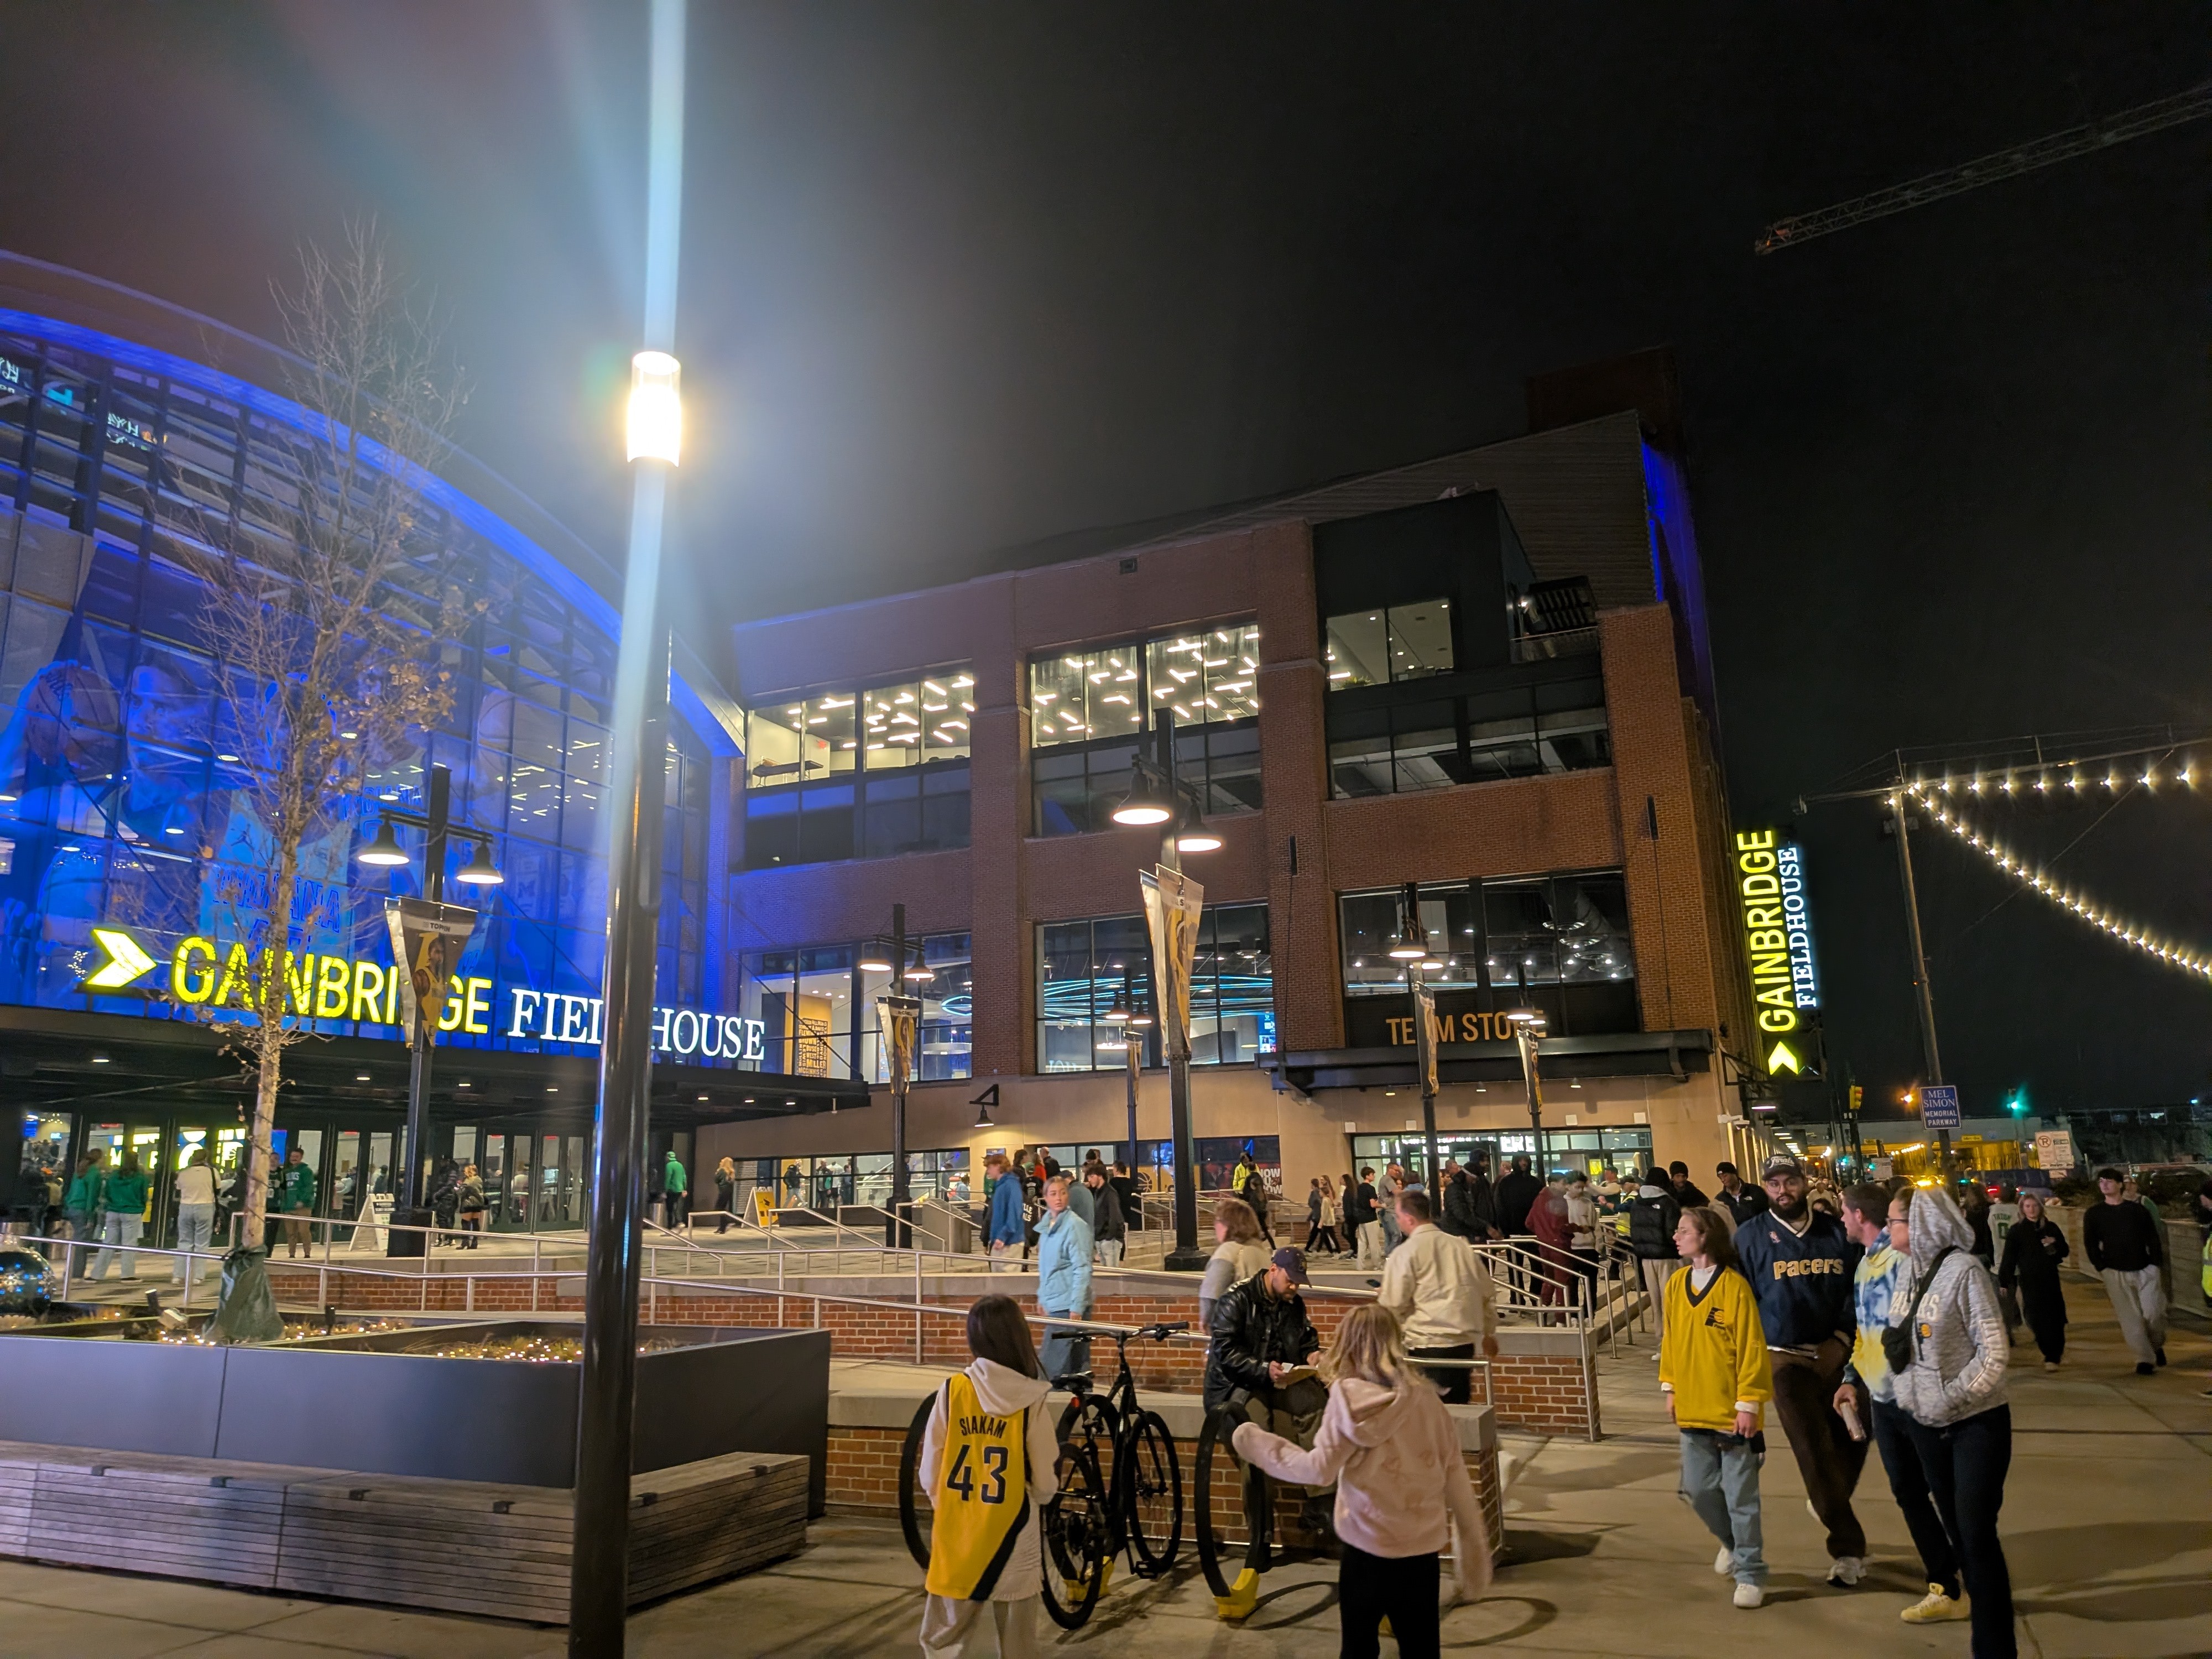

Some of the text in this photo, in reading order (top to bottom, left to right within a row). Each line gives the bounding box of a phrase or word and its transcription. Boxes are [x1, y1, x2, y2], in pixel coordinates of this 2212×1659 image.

[1737, 830, 1796, 1032] GAINBRIDGE
[1777, 847, 1817, 1008] FIELDHOUSE
[173, 935, 492, 1034] GAINBRIGE
[508, 989, 765, 1060] FIELHOUSE
[1386, 1014, 1455, 1045] TEM
[1923, 1098, 1955, 1108] SIMON
[1928, 1089, 1949, 1099] MEL
[959, 1415, 1007, 1438] SIAKAM
[946, 1444, 1009, 1504] 43
